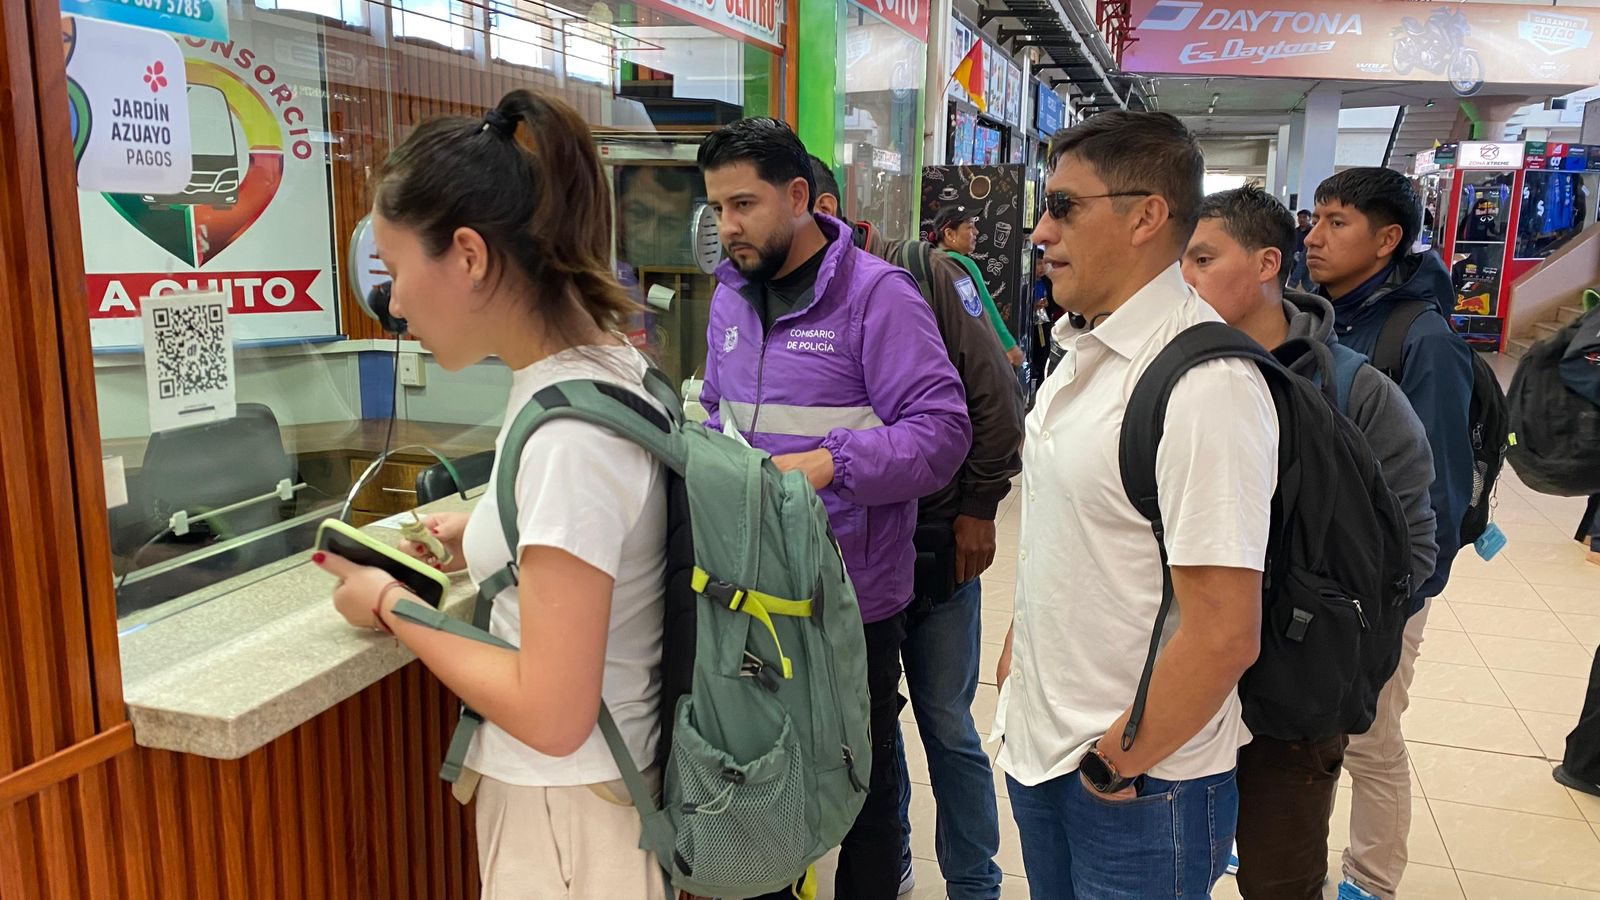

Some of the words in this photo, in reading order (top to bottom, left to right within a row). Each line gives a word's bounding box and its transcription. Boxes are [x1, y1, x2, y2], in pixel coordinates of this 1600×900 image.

[1199, 9, 1363, 36] DAYTONA
[1221, 38, 1337, 64] Daytona
[112, 97, 169, 122] JARDÍN
[174, 34, 312, 160] ONSORCIO
[111, 121, 171, 145] AZUAYO
[126, 148, 172, 167] PAGOS
[98, 280, 135, 311] A
[786, 340, 798, 350] DE
[799, 340, 835, 353] POLICÍA
[790, 329, 835, 339] COMISARIO
